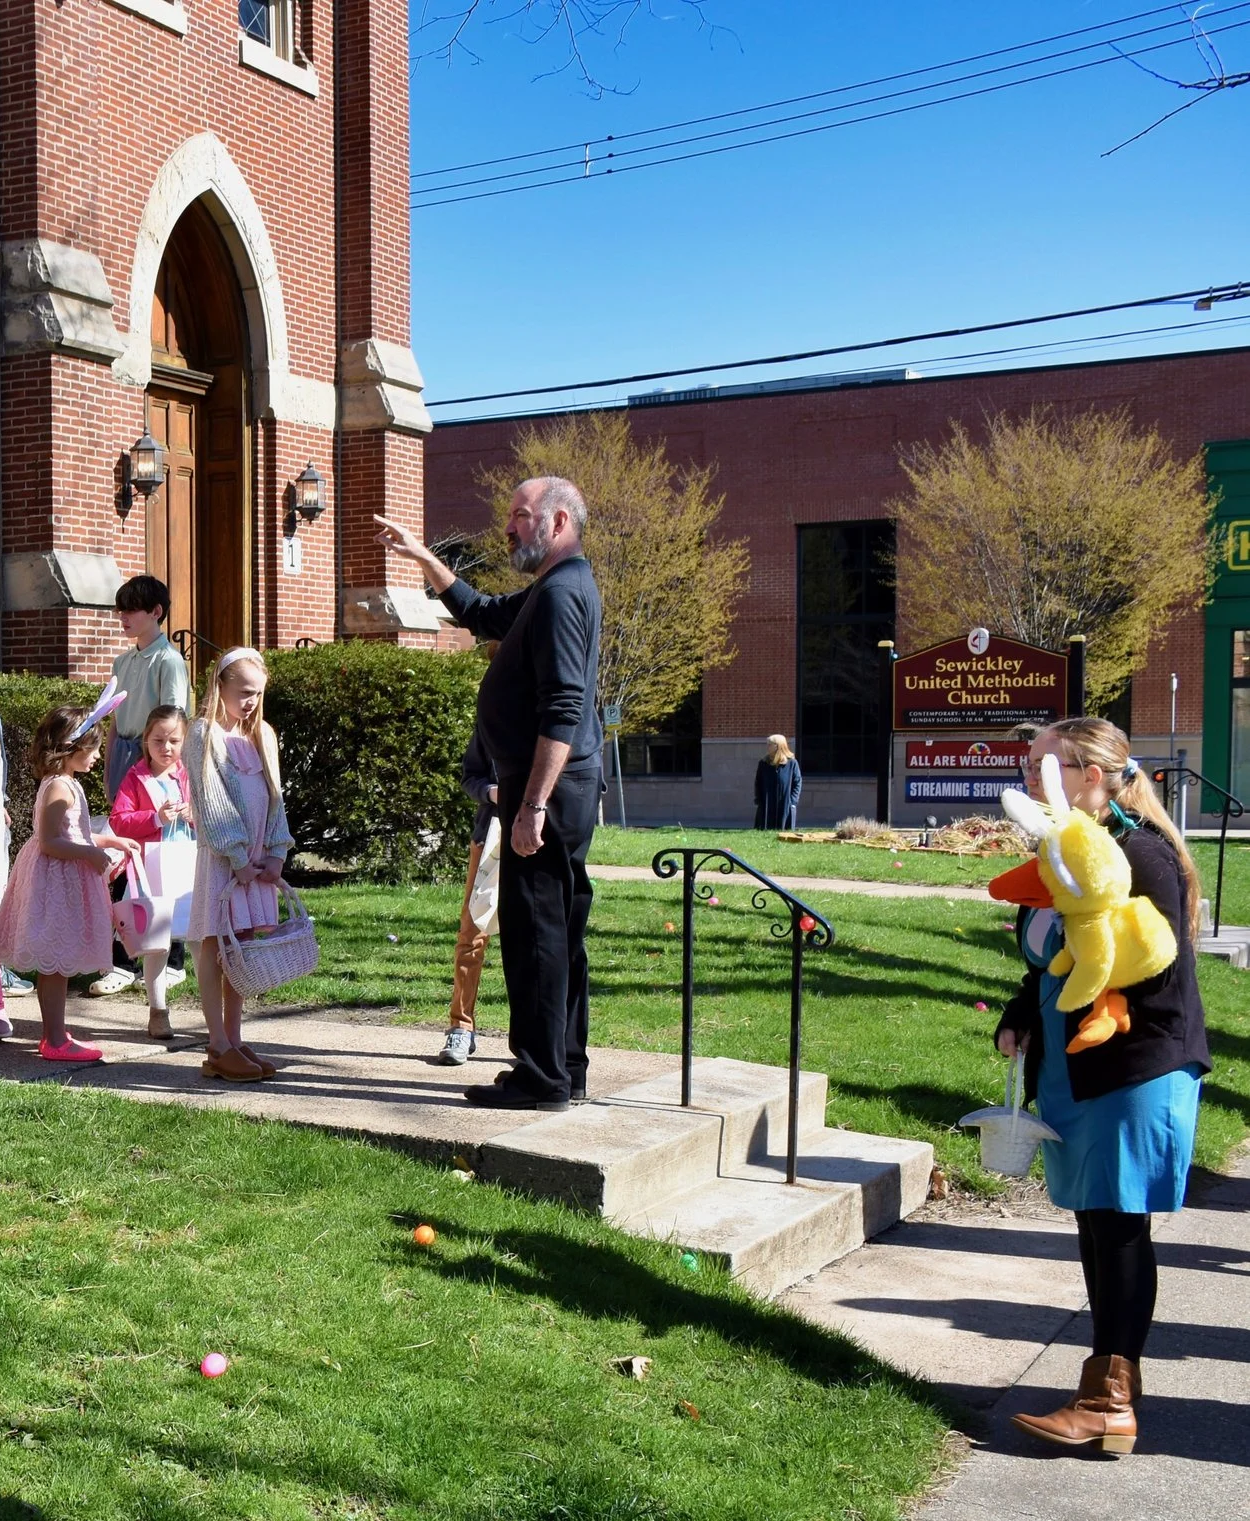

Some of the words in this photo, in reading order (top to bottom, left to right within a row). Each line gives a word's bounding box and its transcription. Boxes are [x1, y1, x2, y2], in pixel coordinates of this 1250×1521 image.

[288, 544, 295, 568] 1
[935, 656, 1023, 675] Sewickley
[904, 675, 962, 690] United
[967, 673, 1057, 689] Methodist
[947, 690, 1011, 705] Church
[910, 755, 931, 767] ALL
[933, 755, 956, 767] ARE
[959, 755, 1016, 767] WELCOME
[910, 782, 970, 797] STREAMING
